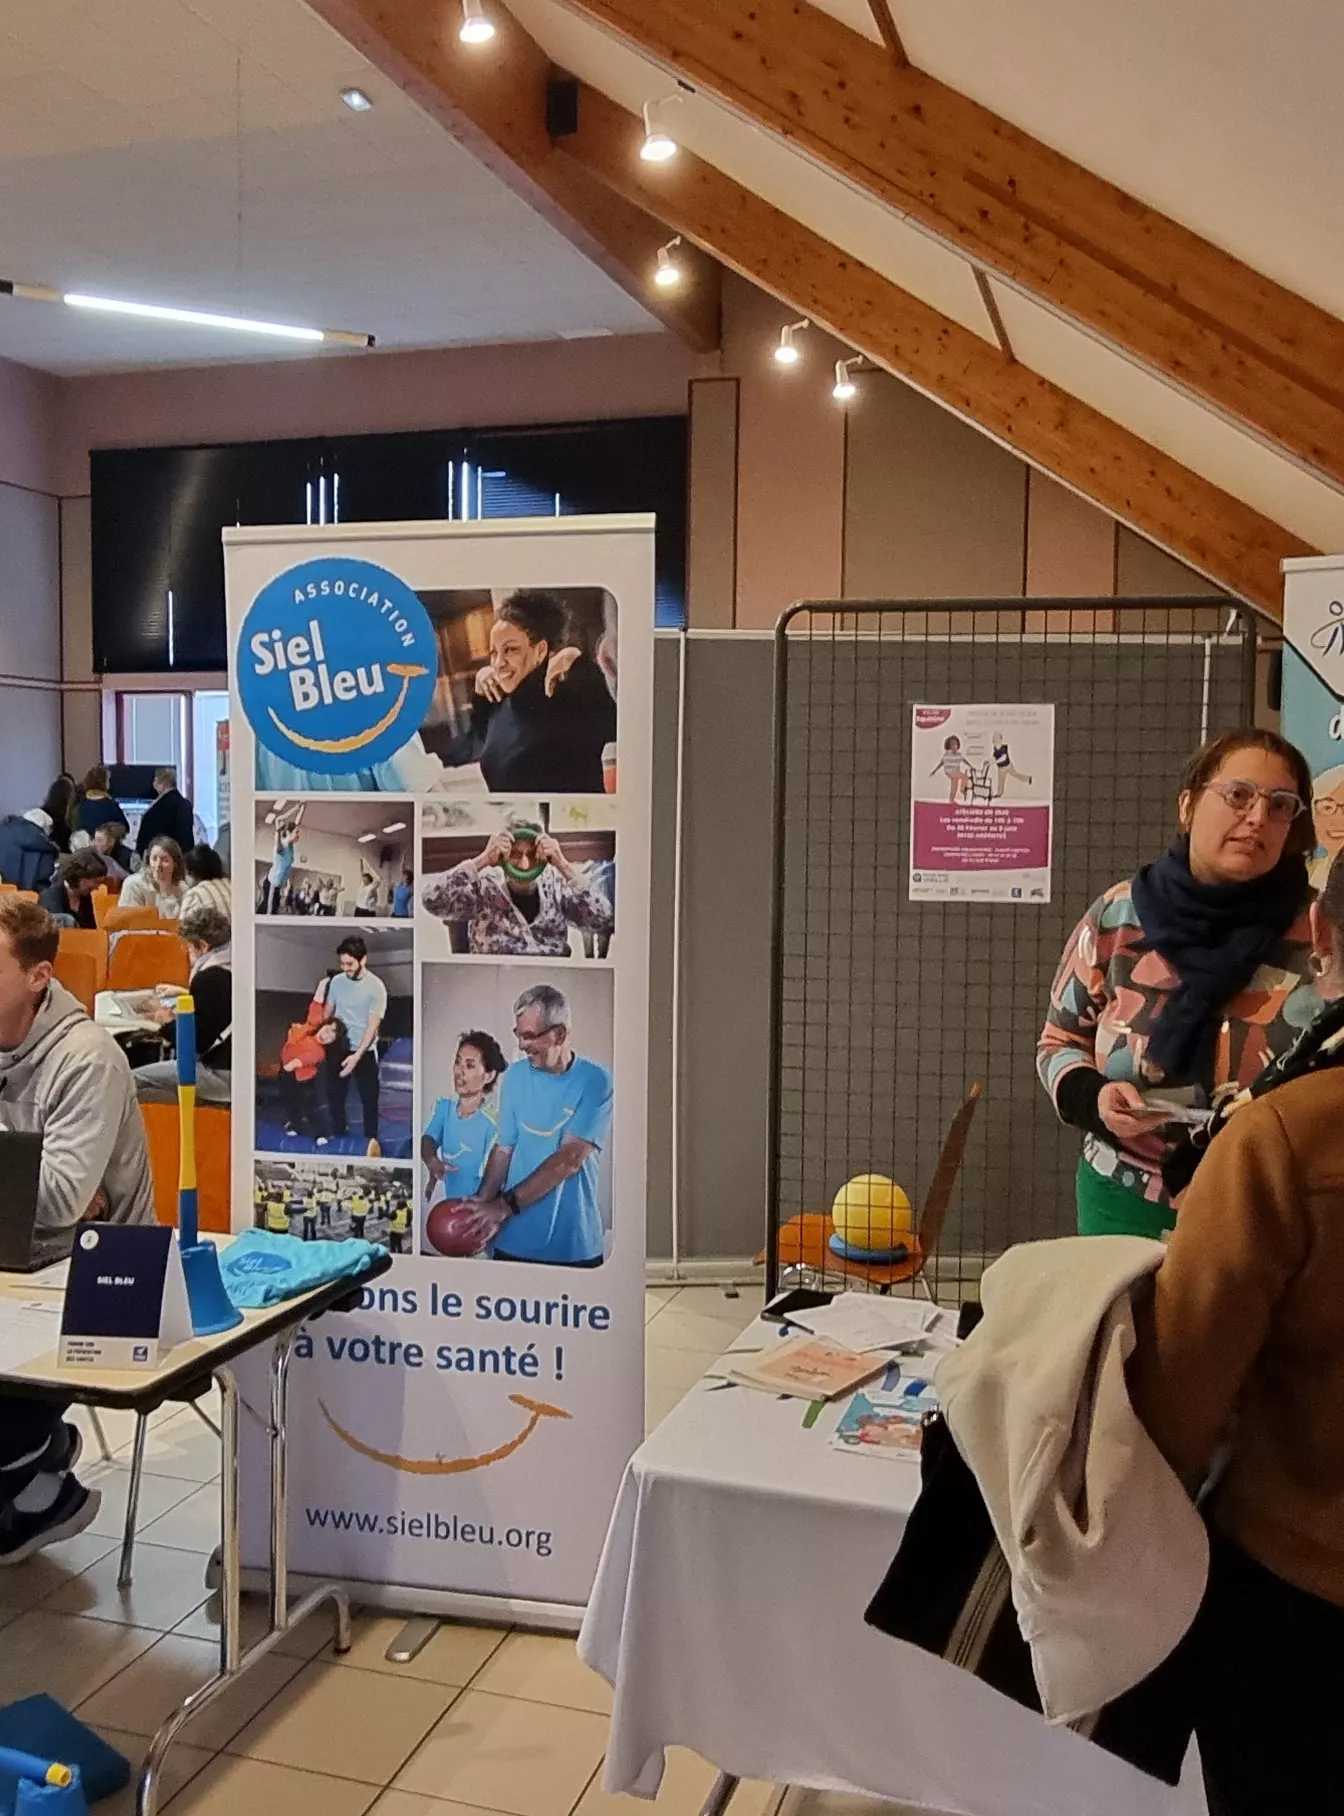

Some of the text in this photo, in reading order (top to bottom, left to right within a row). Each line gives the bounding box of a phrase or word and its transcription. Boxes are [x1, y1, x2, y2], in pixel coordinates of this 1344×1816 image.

[292, 580, 416, 648] ASSOCIATION
[250, 619, 324, 676] Siel
[289, 661, 386, 713] Bleu
[97, 1275, 135, 1287] SIEL BLEU
[358, 1282, 611, 1331] ons le sourire
[294, 1327, 564, 1380] à votre santé !
[305, 1507, 553, 1557] www.sielbleu.org
